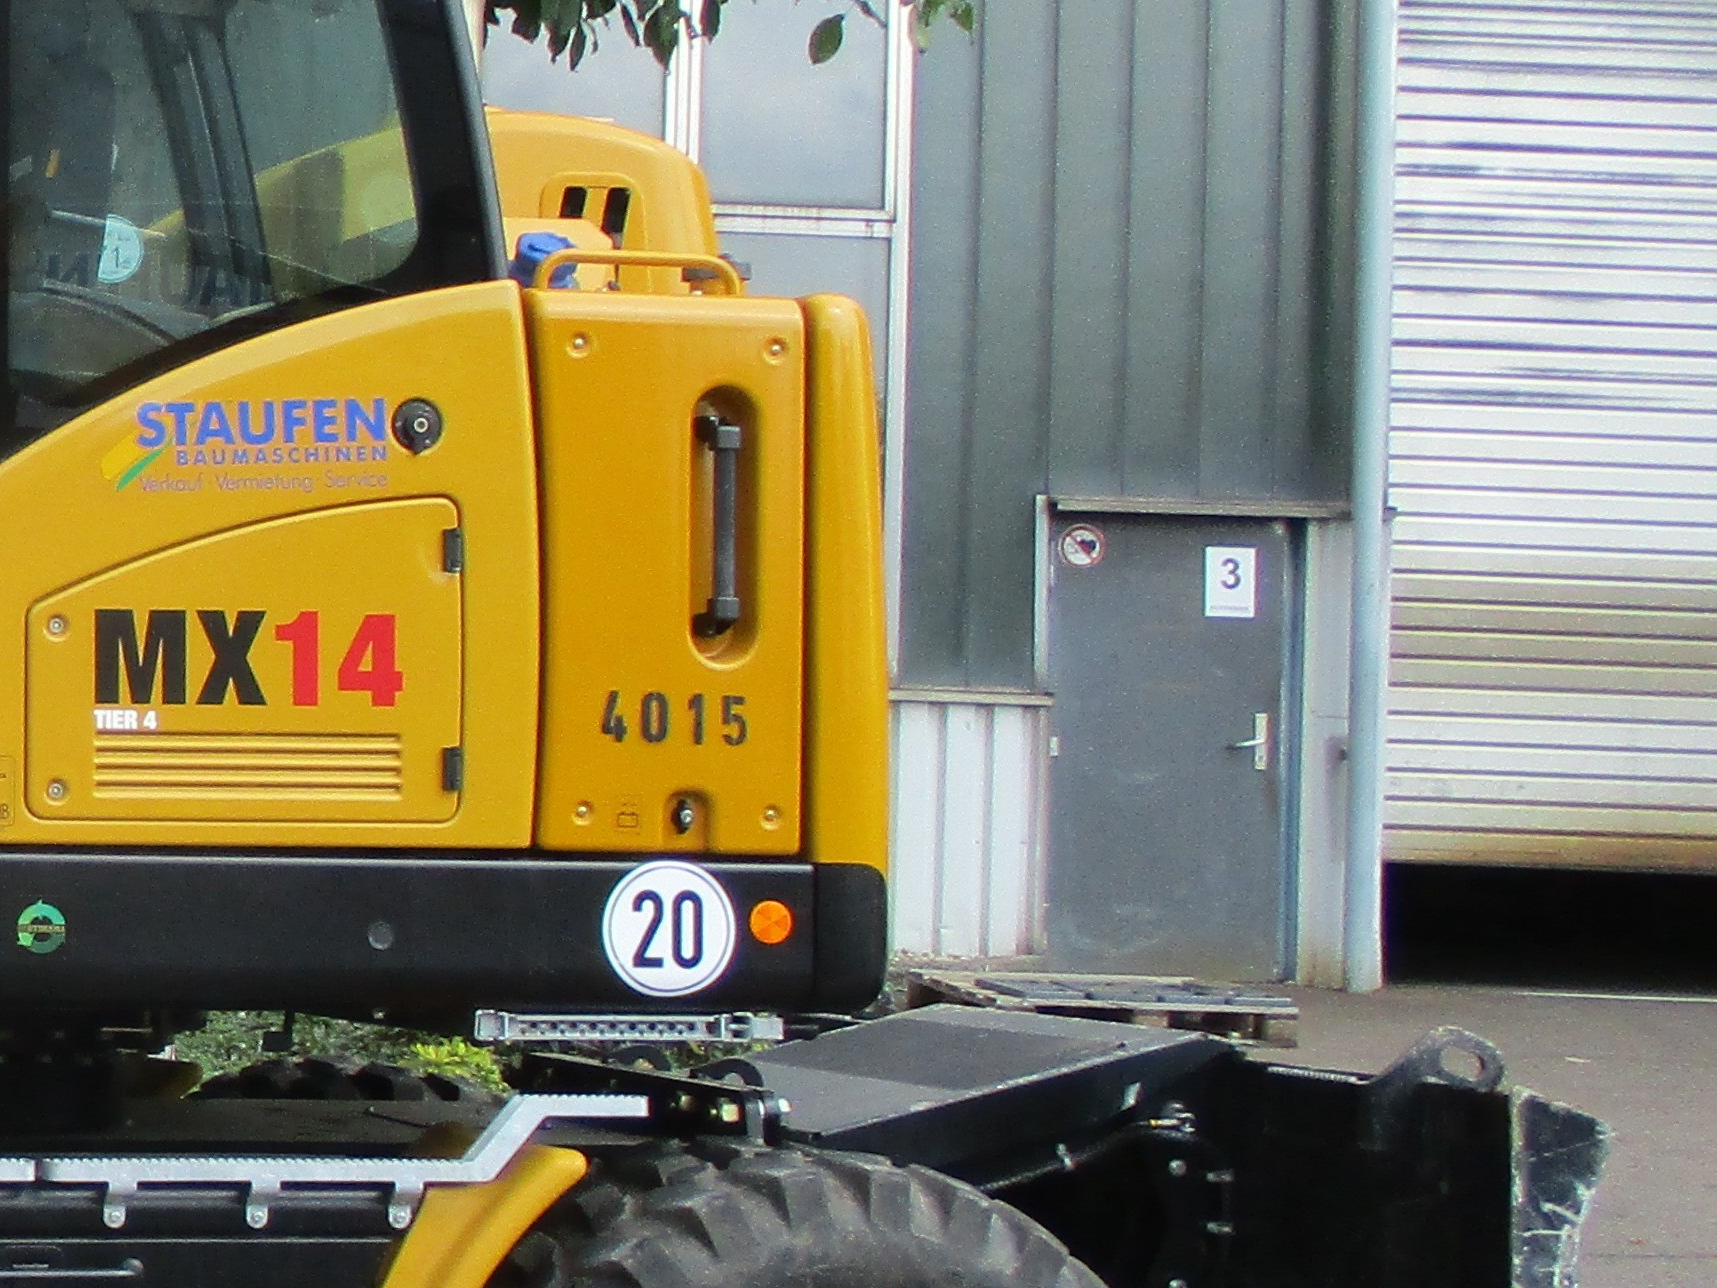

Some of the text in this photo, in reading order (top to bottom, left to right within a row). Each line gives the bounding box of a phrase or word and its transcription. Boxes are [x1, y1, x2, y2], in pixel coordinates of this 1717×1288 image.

[135, 398, 386, 448] STAUFEN
[176, 445, 387, 466] BAUMASCHINEN
[324, 469, 388, 489] Service
[1220, 557, 1242, 590] 3
[94, 609, 404, 707] MX14
[93, 710, 158, 730] TIER 4
[601, 689, 748, 746] 4015
[632, 889, 703, 969] 20
